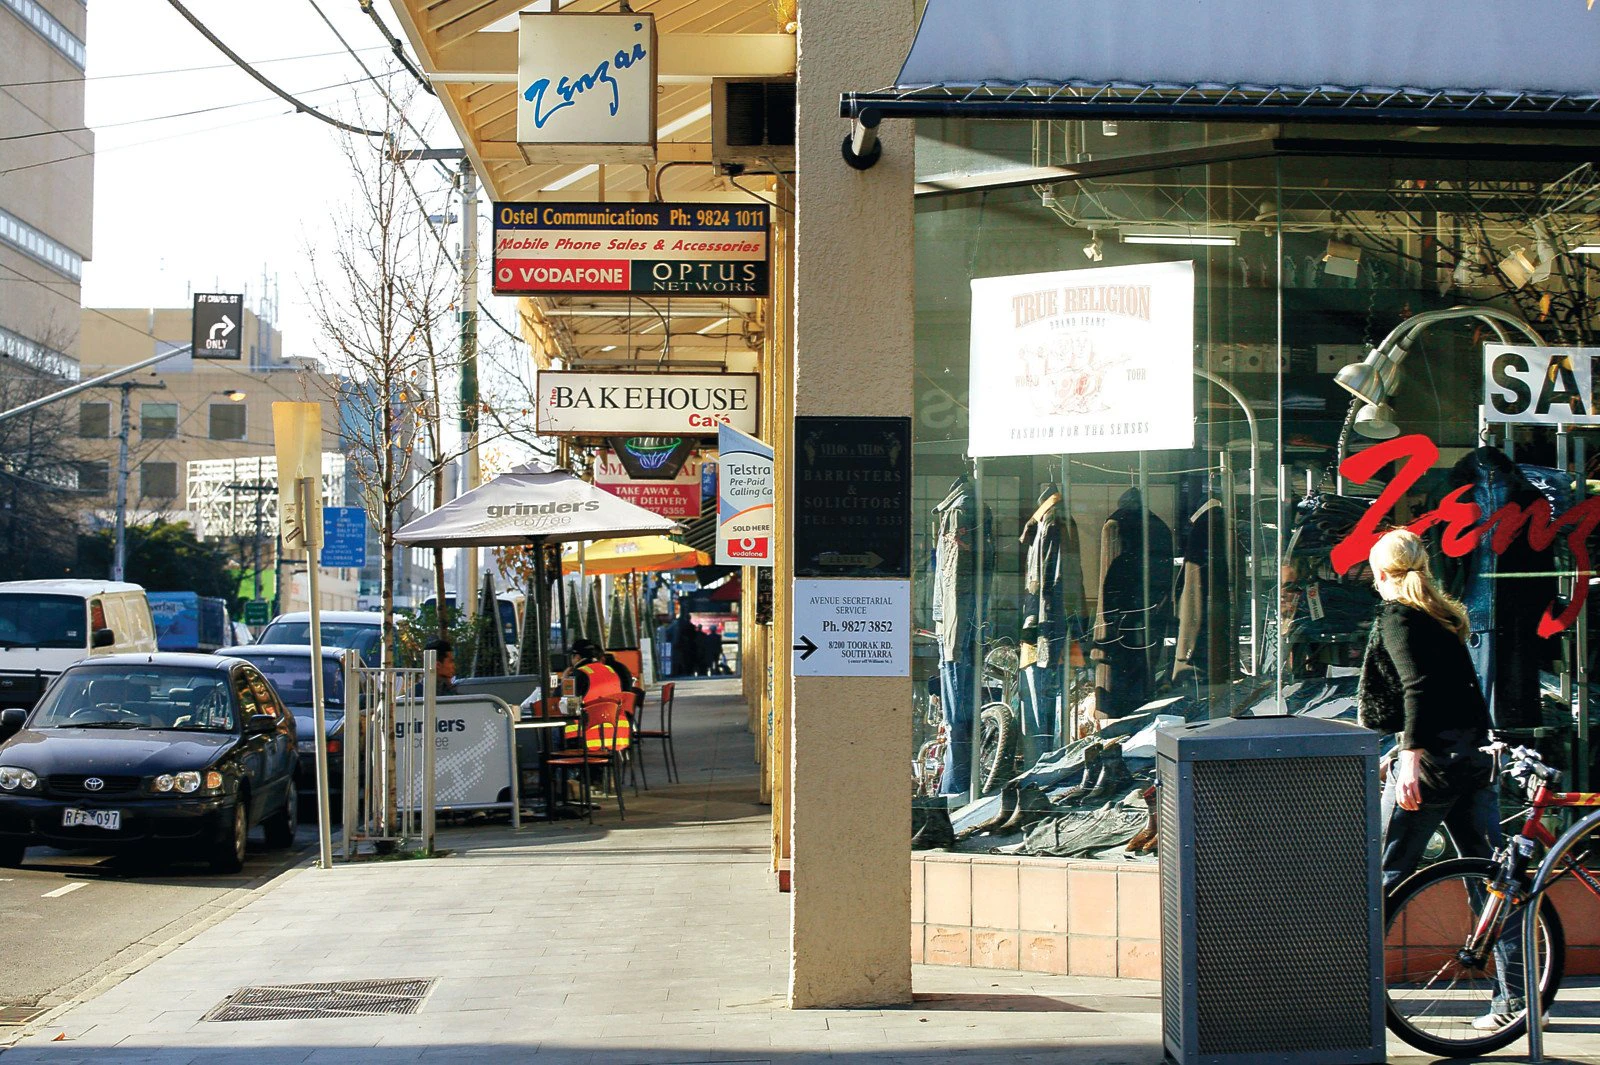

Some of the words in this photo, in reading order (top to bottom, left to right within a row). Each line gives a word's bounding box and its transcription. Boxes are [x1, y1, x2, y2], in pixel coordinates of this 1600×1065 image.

[501, 207, 538, 225] Ostel
[543, 208, 659, 226] Communications
[669, 209, 691, 226] Ph:
[696, 210, 730, 226] 9824
[737, 210, 764, 227] 1011
[499, 238, 549, 251] Mobile
[554, 239, 601, 251] Phone
[607, 239, 647, 251] Sales
[652, 239, 665, 251] &
[671, 239, 760, 253] Accessories
[519, 267, 623, 283] VODAFONE
[652, 262, 756, 281] OPTUS
[652, 281, 756, 292] NETWORK
[1011, 290, 1058, 329] TRUE
[1064, 285, 1151, 322] RELIGION
[206, 339, 228, 350] ONLY
[1126, 368, 1146, 381] TOUR
[554, 386, 749, 411] BAKEHOUSE
[1060, 425, 1079, 437] FOR
[1084, 423, 1105, 436] THE
[1110, 421, 1150, 436] SENSES
[727, 464, 771, 476] Telstra
[803, 469, 901, 482] BARRISTERS
[730, 477, 766, 486] Pre-Paid
[615, 486, 640, 495] TAKE
[642, 486, 670, 496] AWAY
[672, 487, 681, 495] &
[730, 488, 760, 498] Calling
[847, 484, 857, 495] &
[640, 496, 688, 506] DELIVERY
[803, 496, 901, 509] SOLICITORS
[340, 508, 348, 517] P
[486, 500, 600, 519] grinders
[514, 514, 572, 528] coffee
[732, 550, 763, 558] vodafone
[810, 597, 840, 605] AVENUE
[842, 597, 893, 605] SECRETARIAL
[835, 606, 867, 615] SERVICE
[822, 620, 840, 632] Ph.
[841, 620, 866, 633] 9827
[868, 620, 893, 633] 3852
[828, 641, 845, 650] 8/200
[847, 641, 879, 650] TOORAK
[880, 641, 893, 649] RD.
[841, 650, 867, 658] SOUTH
[867, 650, 893, 658] YARRA
[96, 812, 119, 826] 097
